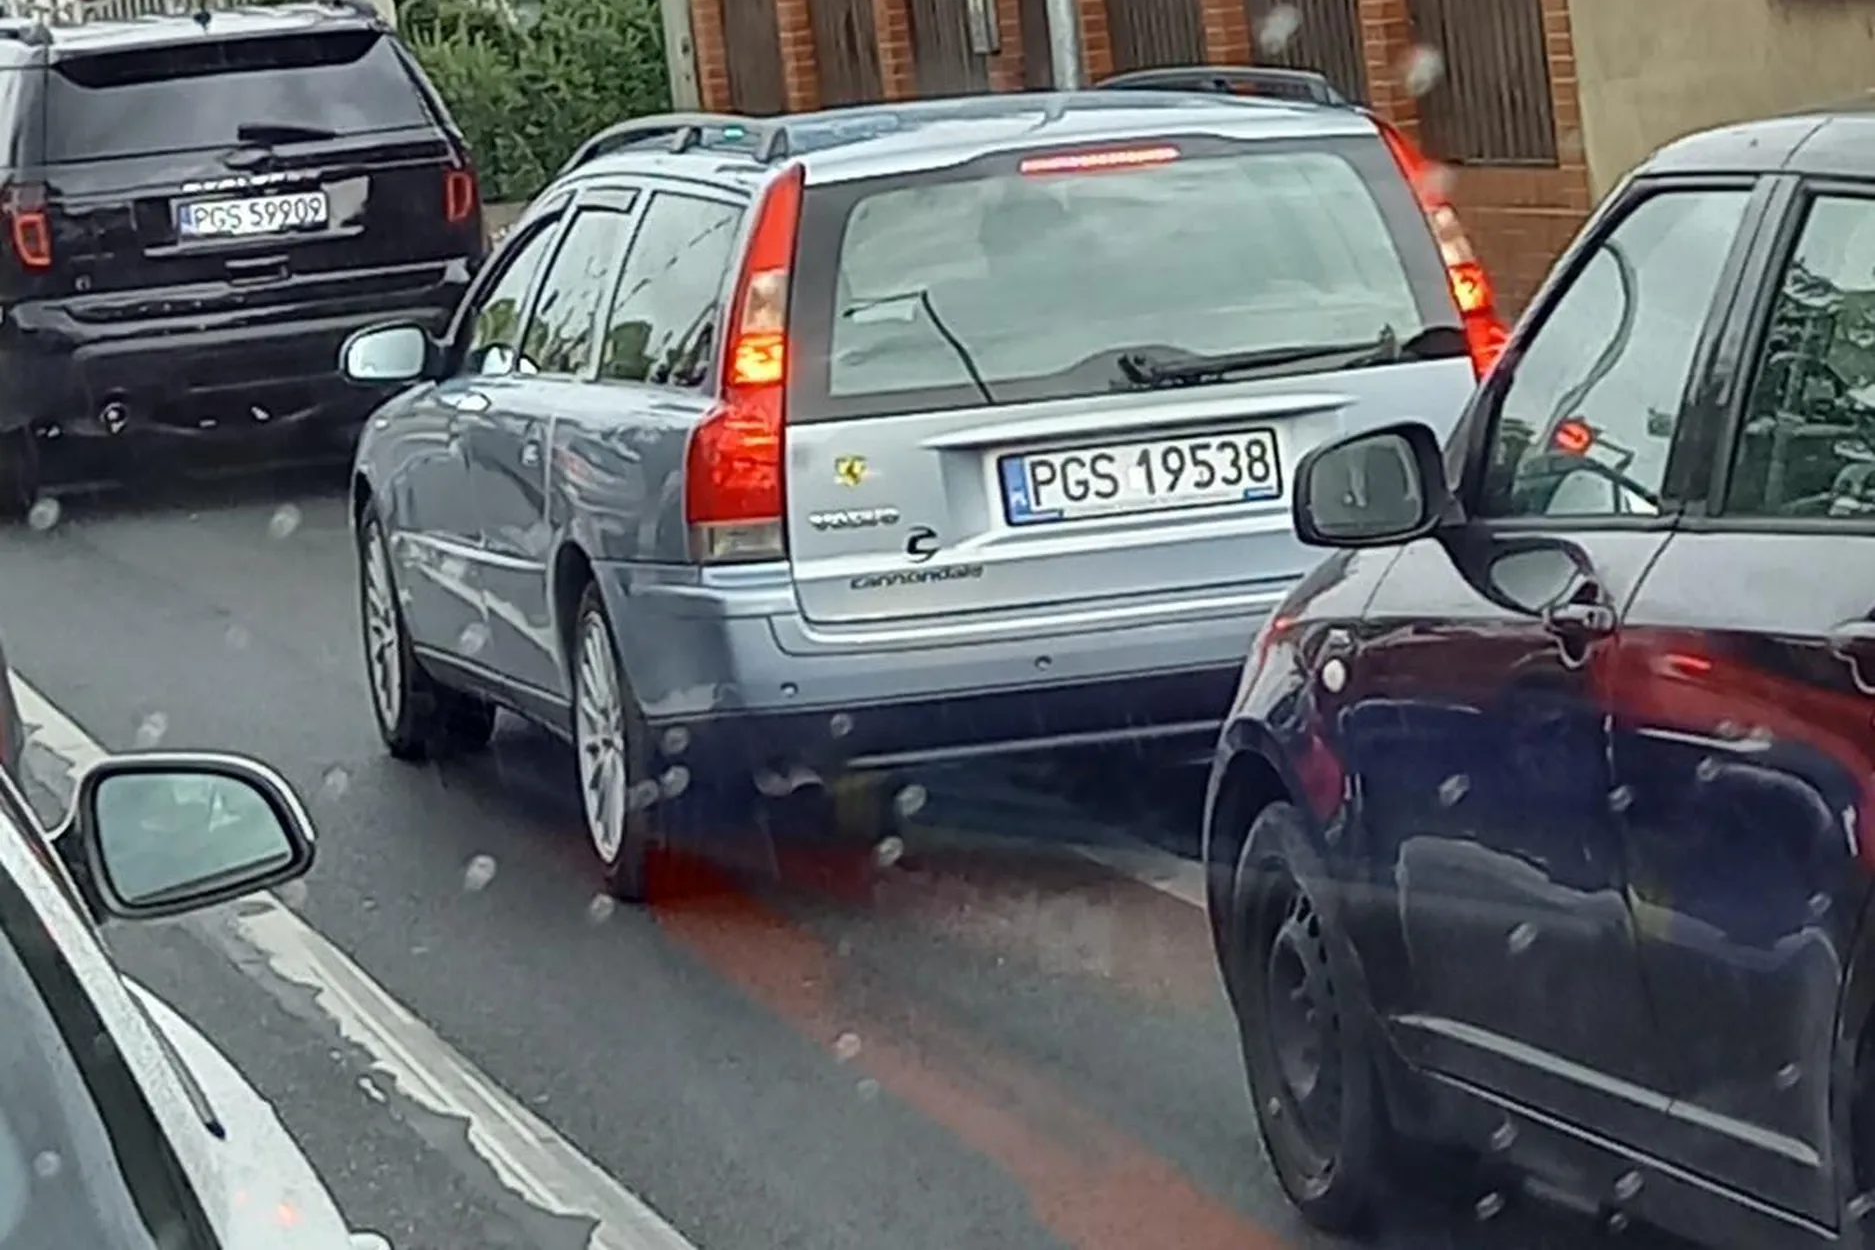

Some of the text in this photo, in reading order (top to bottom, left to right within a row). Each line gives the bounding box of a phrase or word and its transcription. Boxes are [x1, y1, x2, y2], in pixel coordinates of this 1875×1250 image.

[194, 196, 322, 229] PGS 59909
[1029, 438, 1271, 507] PGS 19538
